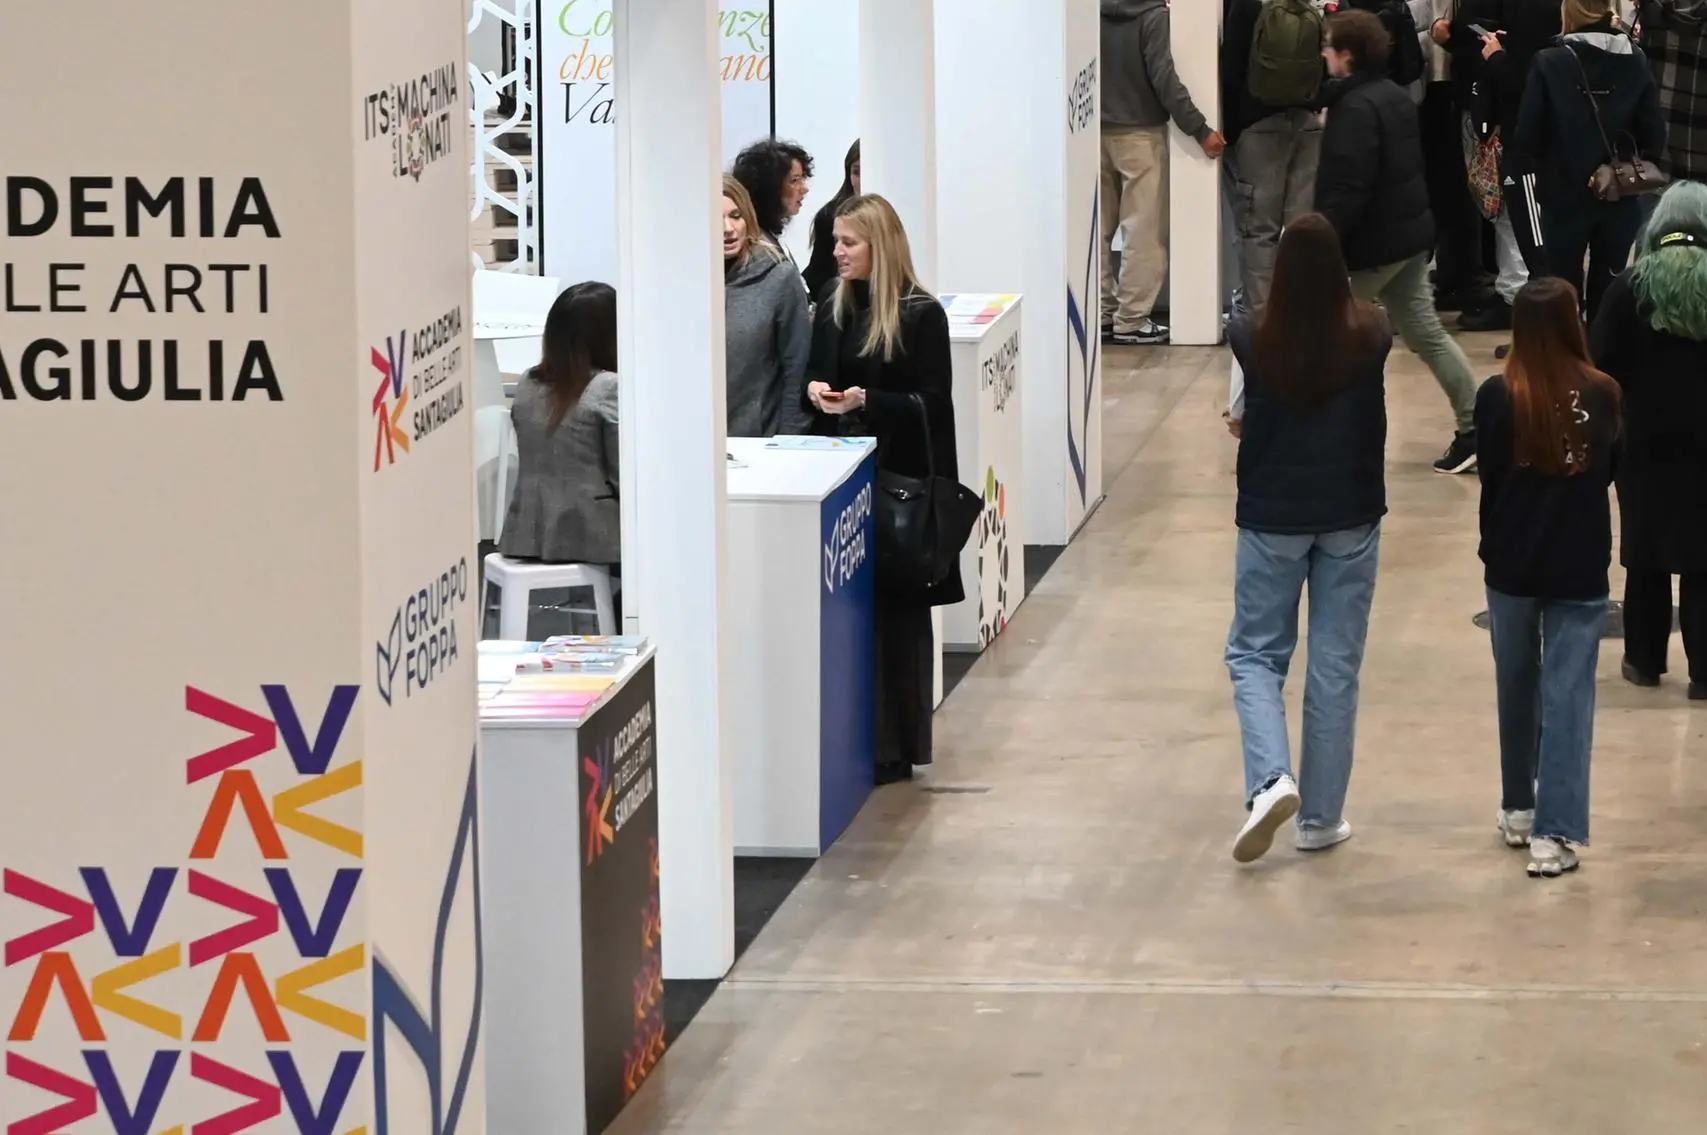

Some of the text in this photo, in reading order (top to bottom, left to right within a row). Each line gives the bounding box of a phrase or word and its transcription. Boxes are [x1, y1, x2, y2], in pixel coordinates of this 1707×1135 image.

[364, 61, 458, 141] ITS MACHINA
[6, 176, 281, 238] DEMIA
[5, 263, 268, 313] LE ARTI
[413, 305, 463, 364] ACCADEMIA
[0, 338, 284, 402] GIULIA
[413, 381, 464, 441] SANTAGIULIA
[840, 482, 872, 546] GRUPPO
[840, 528, 866, 586] FOPPA
[405, 556, 467, 643] GRUPPO
[406, 618, 458, 698] FOPPA
[613, 700, 652, 764] ACCADEMIA
[615, 767, 653, 832] SANTAGIULIA
